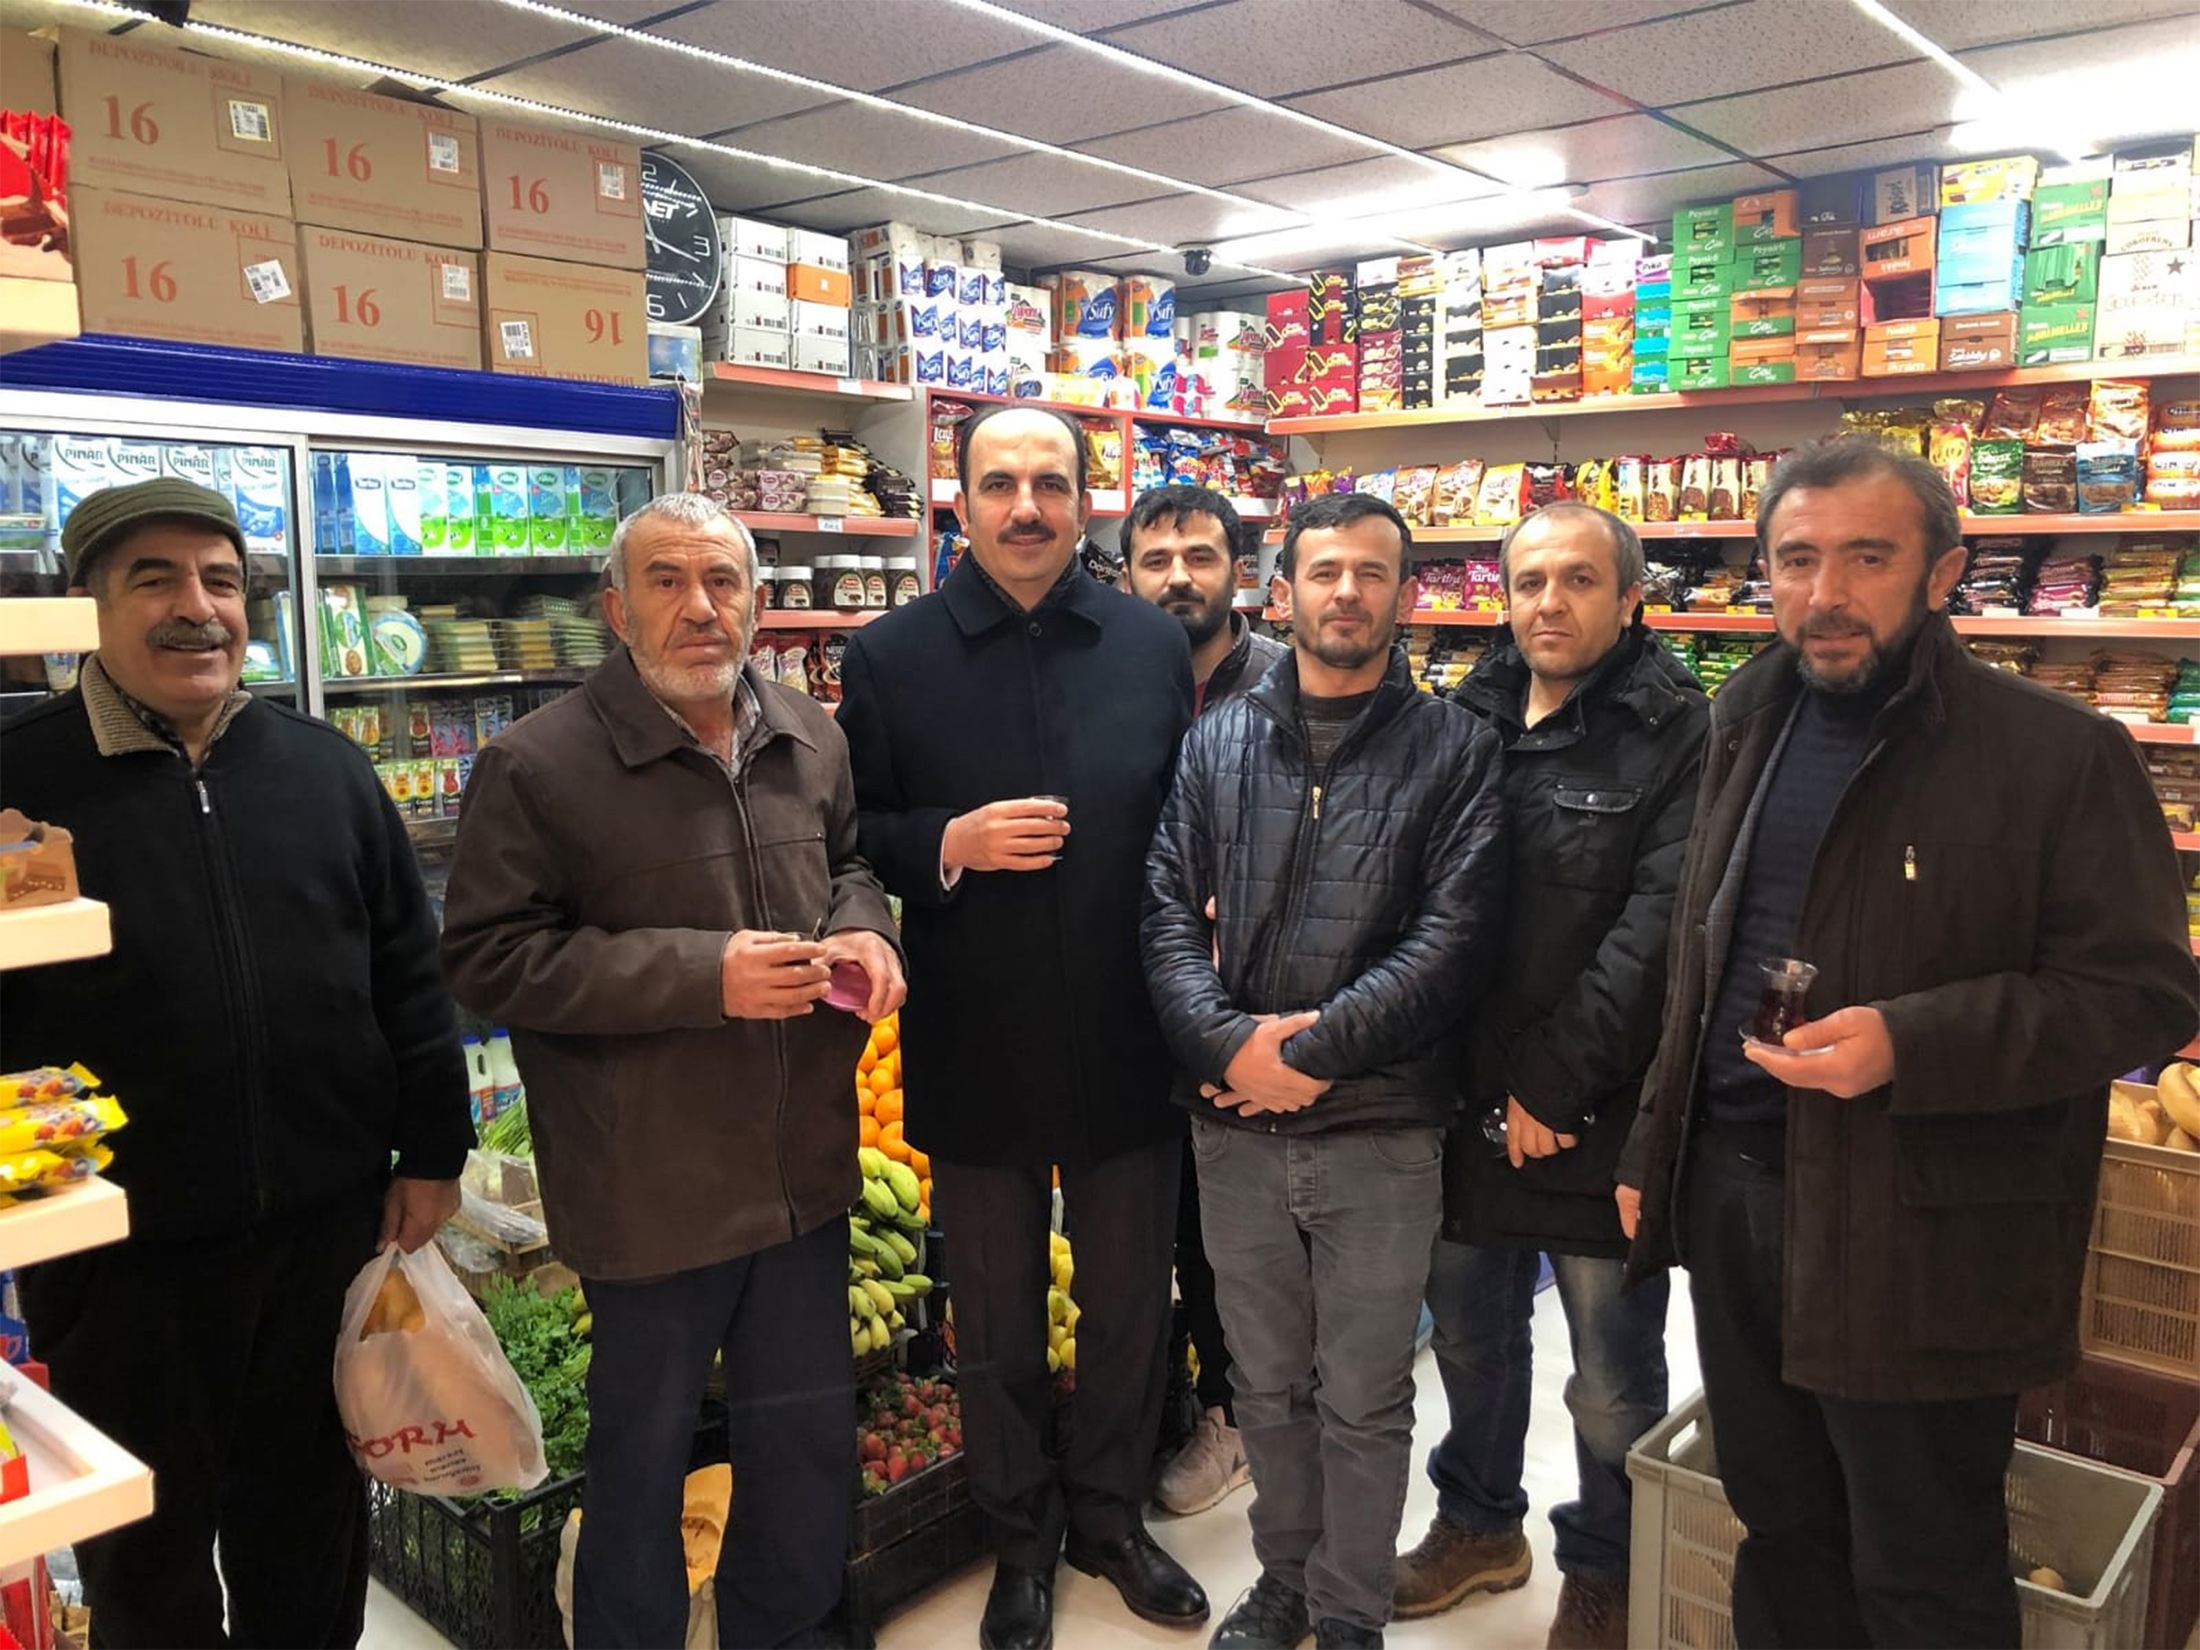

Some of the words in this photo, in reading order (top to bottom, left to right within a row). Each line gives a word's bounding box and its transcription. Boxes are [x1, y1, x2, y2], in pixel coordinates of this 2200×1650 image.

[104, 95, 158, 145] 16
[322, 136, 371, 182] 16
[508, 175, 549, 214] 16
[693, 234, 710, 256] 3
[121, 256, 176, 303] 16
[332, 285, 380, 327] 16
[646, 294, 665, 316] 6
[1088, 303, 1115, 320] Sufy
[585, 309, 622, 345] 16
